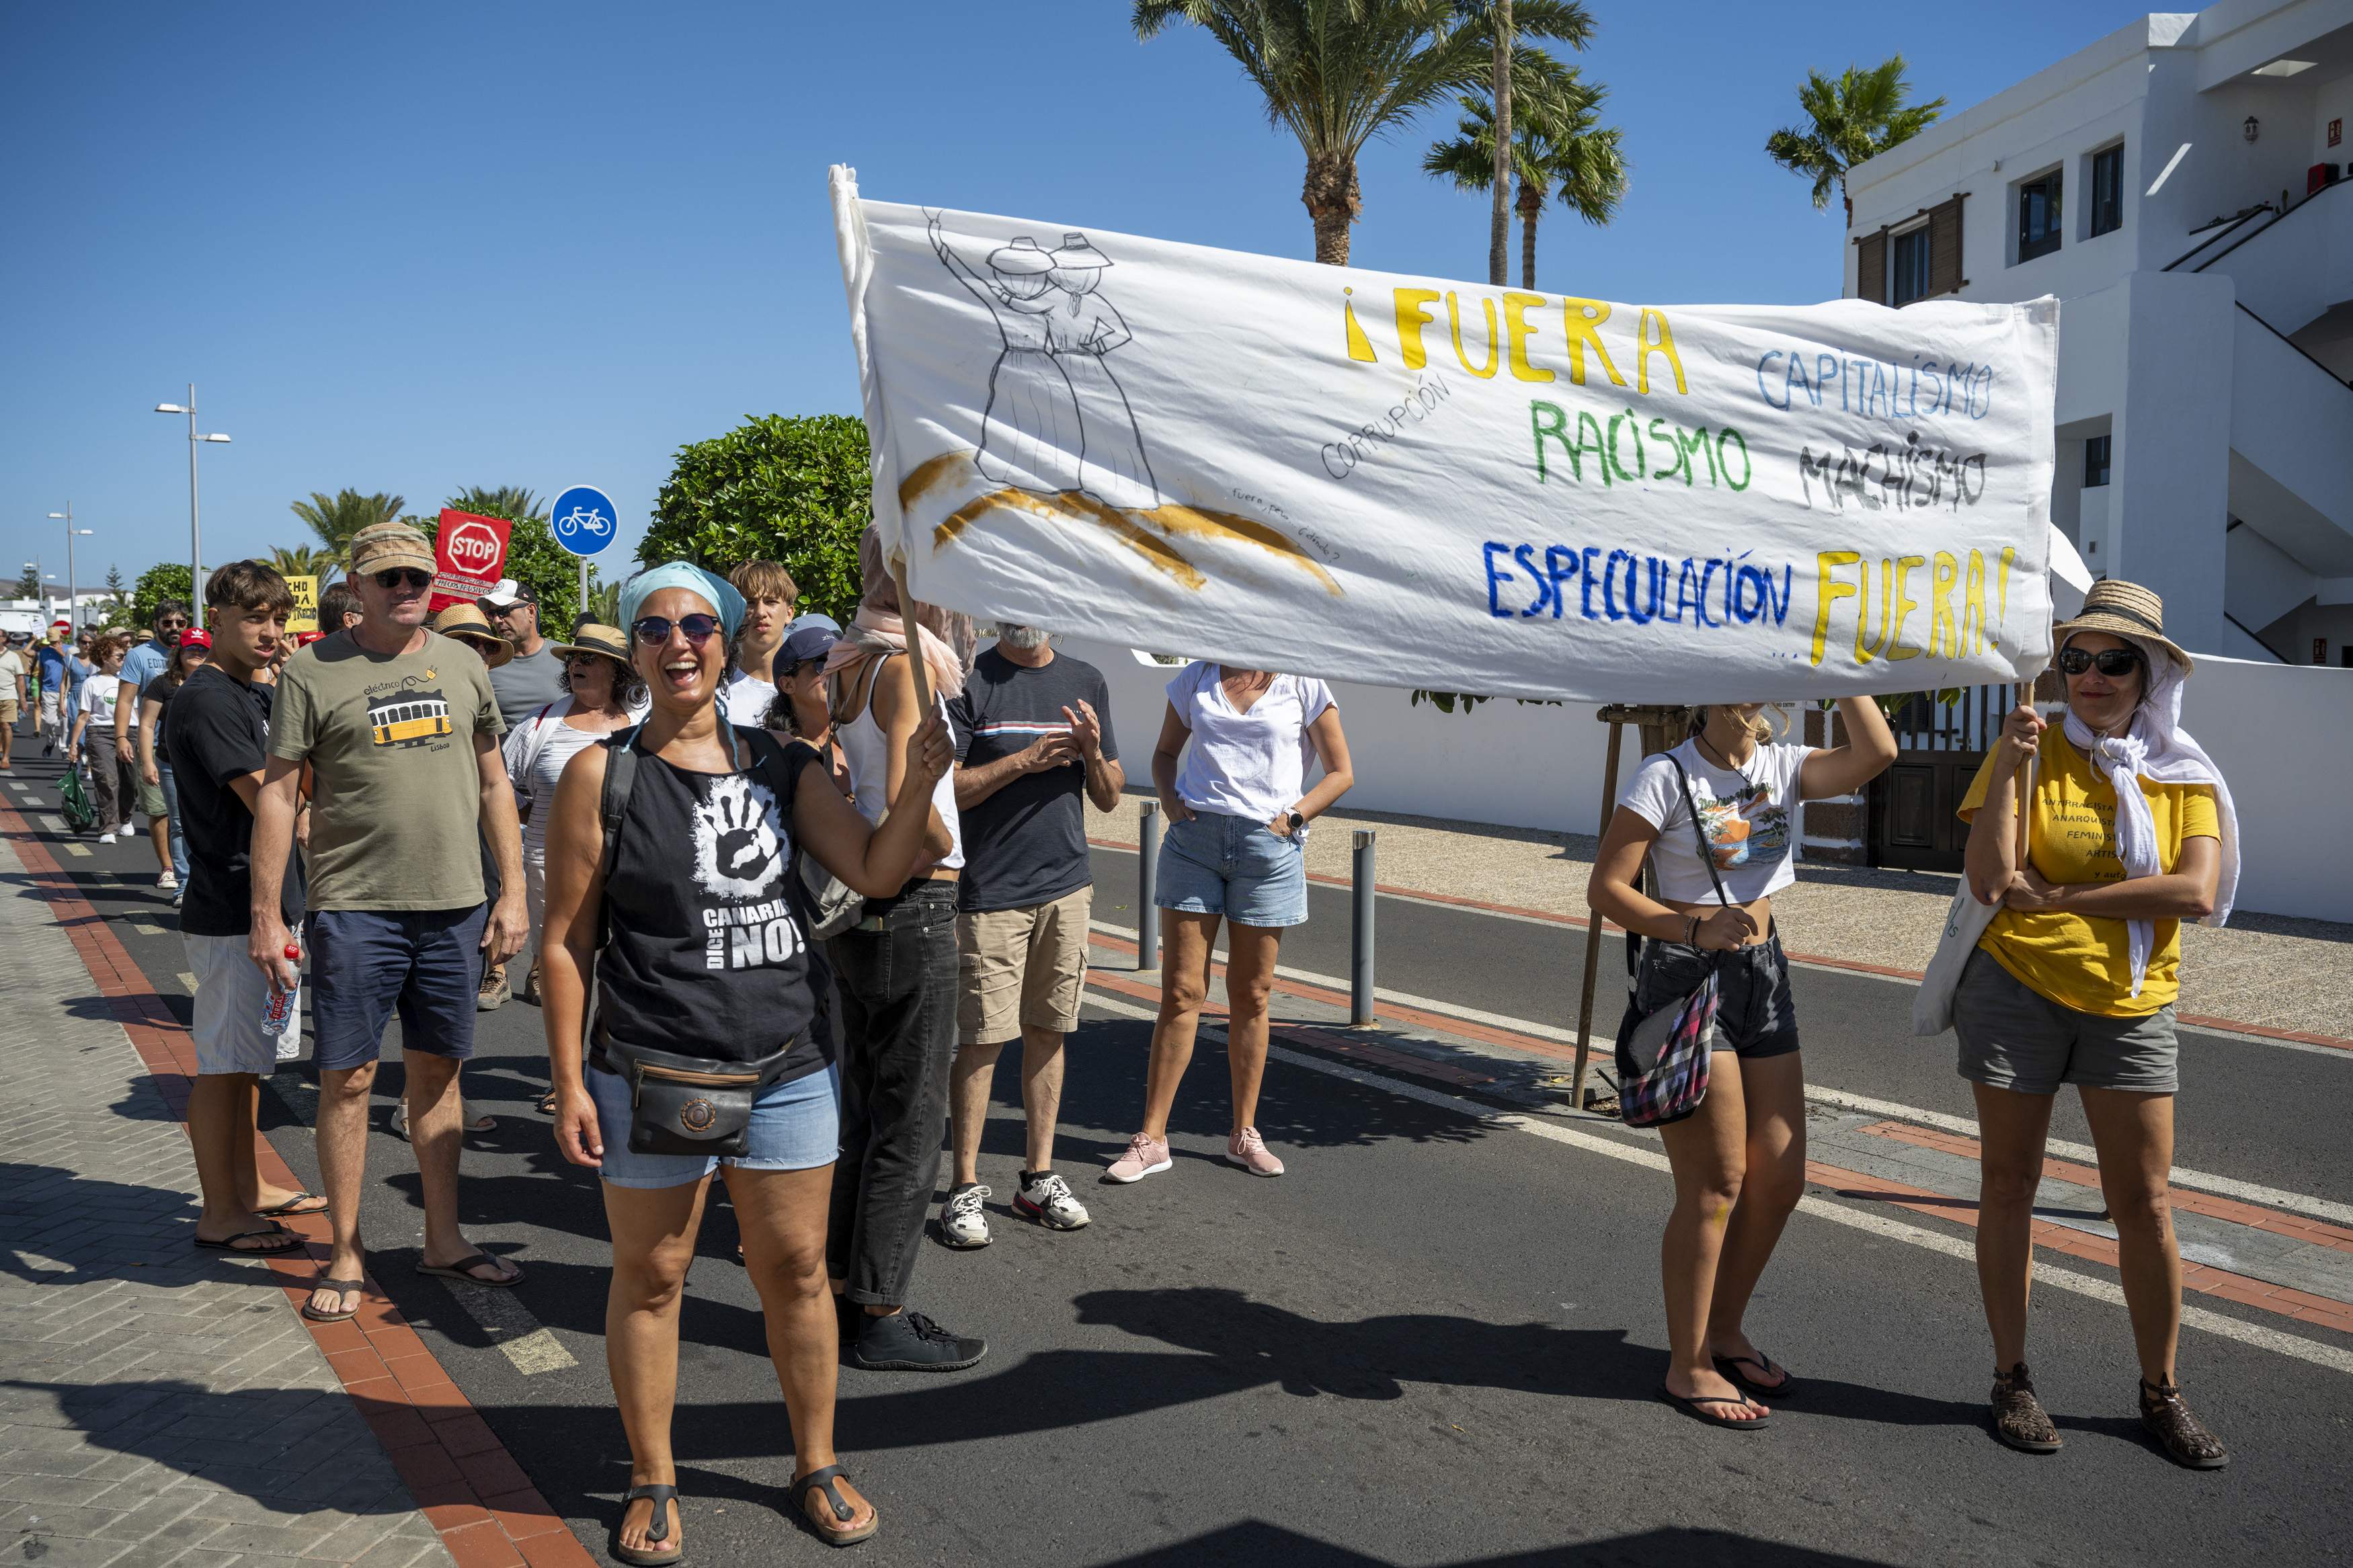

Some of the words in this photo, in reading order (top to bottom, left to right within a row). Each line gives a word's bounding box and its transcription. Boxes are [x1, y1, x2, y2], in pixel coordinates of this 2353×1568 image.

[1757, 348, 1992, 420] CAPITALISMO
[1321, 374, 1450, 480] CORRUPCIÓN
[1531, 399, 1751, 492] RACISMO
[1798, 430, 1987, 513] MACHISMO
[453, 537, 494, 560] STOP
[1482, 540, 1792, 630] ESPECULACIÓN
[1811, 546, 2016, 666] FUERA!
[364, 682, 400, 695] eléctrico
[2042, 798, 2114, 813] ANTIRRACISTA
[706, 928, 724, 969] DICE
[731, 916, 805, 968] NO!
